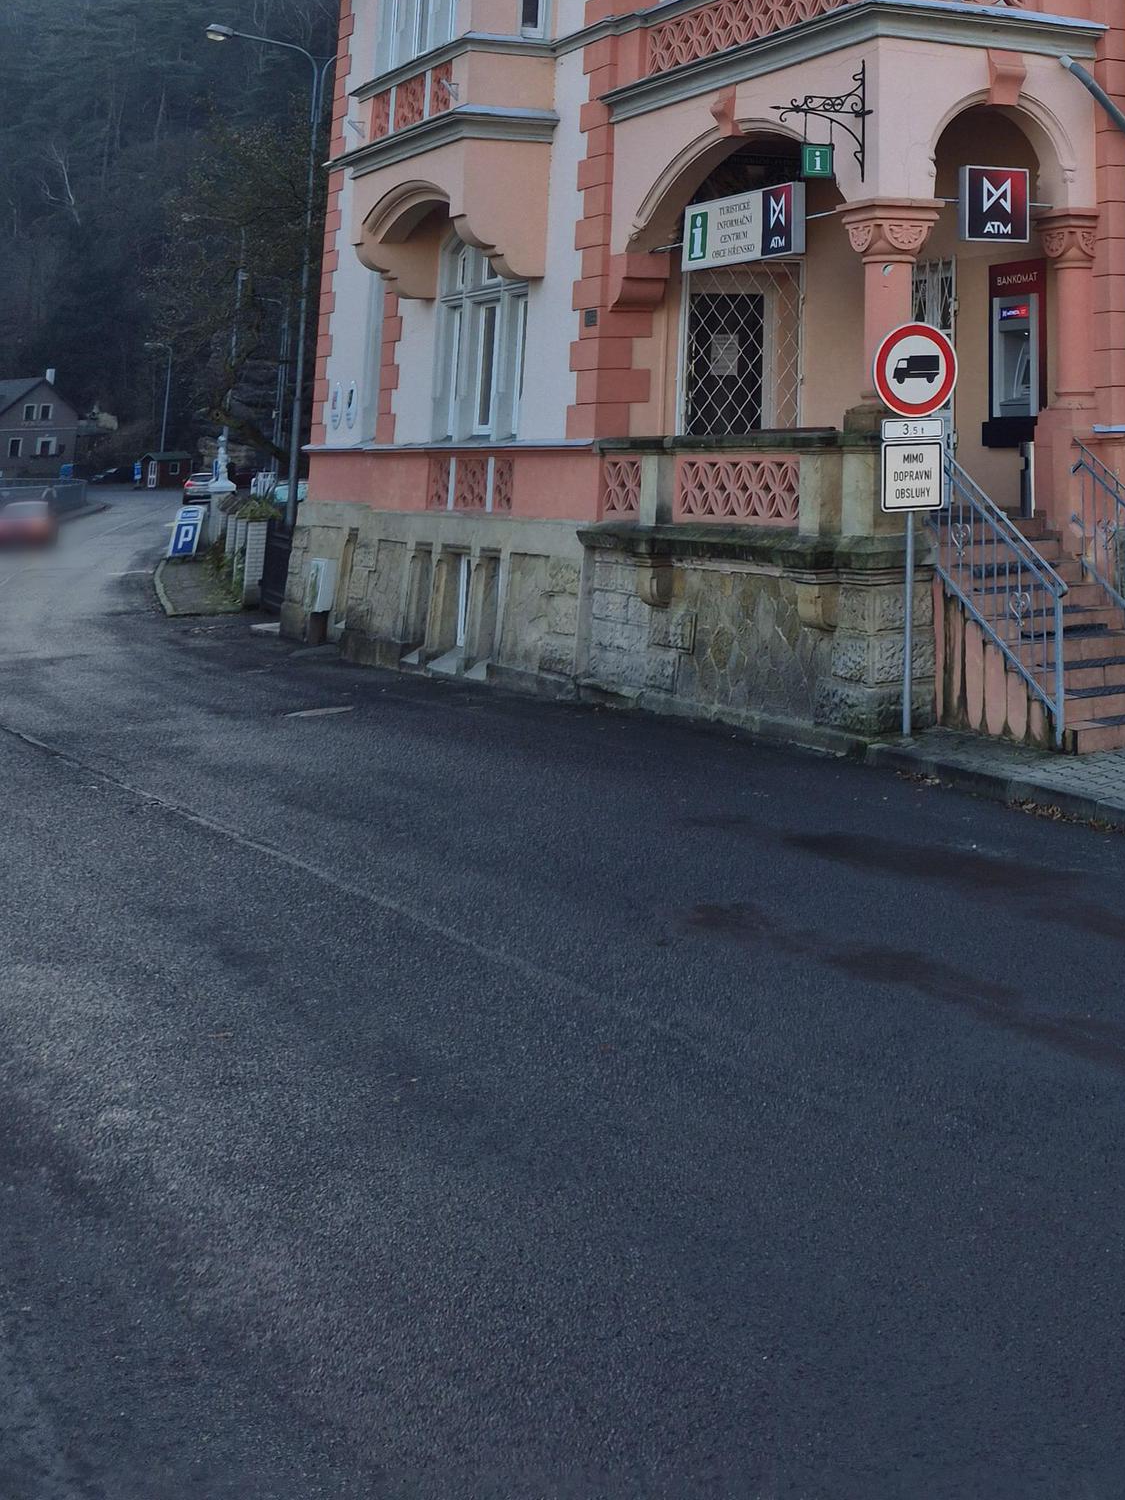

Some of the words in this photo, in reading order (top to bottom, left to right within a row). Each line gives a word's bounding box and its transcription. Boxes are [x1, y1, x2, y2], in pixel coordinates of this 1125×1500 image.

[718, 200, 751, 216] TURISTICKÉ
[717, 214, 753, 230] INFORMAČNÍ
[983, 221, 1012, 234] ATM
[720, 230, 748, 244] CENTRUM
[770, 236, 785, 249] ATM
[711, 248, 727, 259] OBCE
[727, 243, 755, 258] HŘENSKO
[996, 271, 1038, 286] BANKOMAT
[902, 452, 924, 464] MIMO
[893, 467, 932, 482] DOPRAVNÍ
[895, 487, 931, 499] OBSLUHY
[177, 525, 194, 549] P
